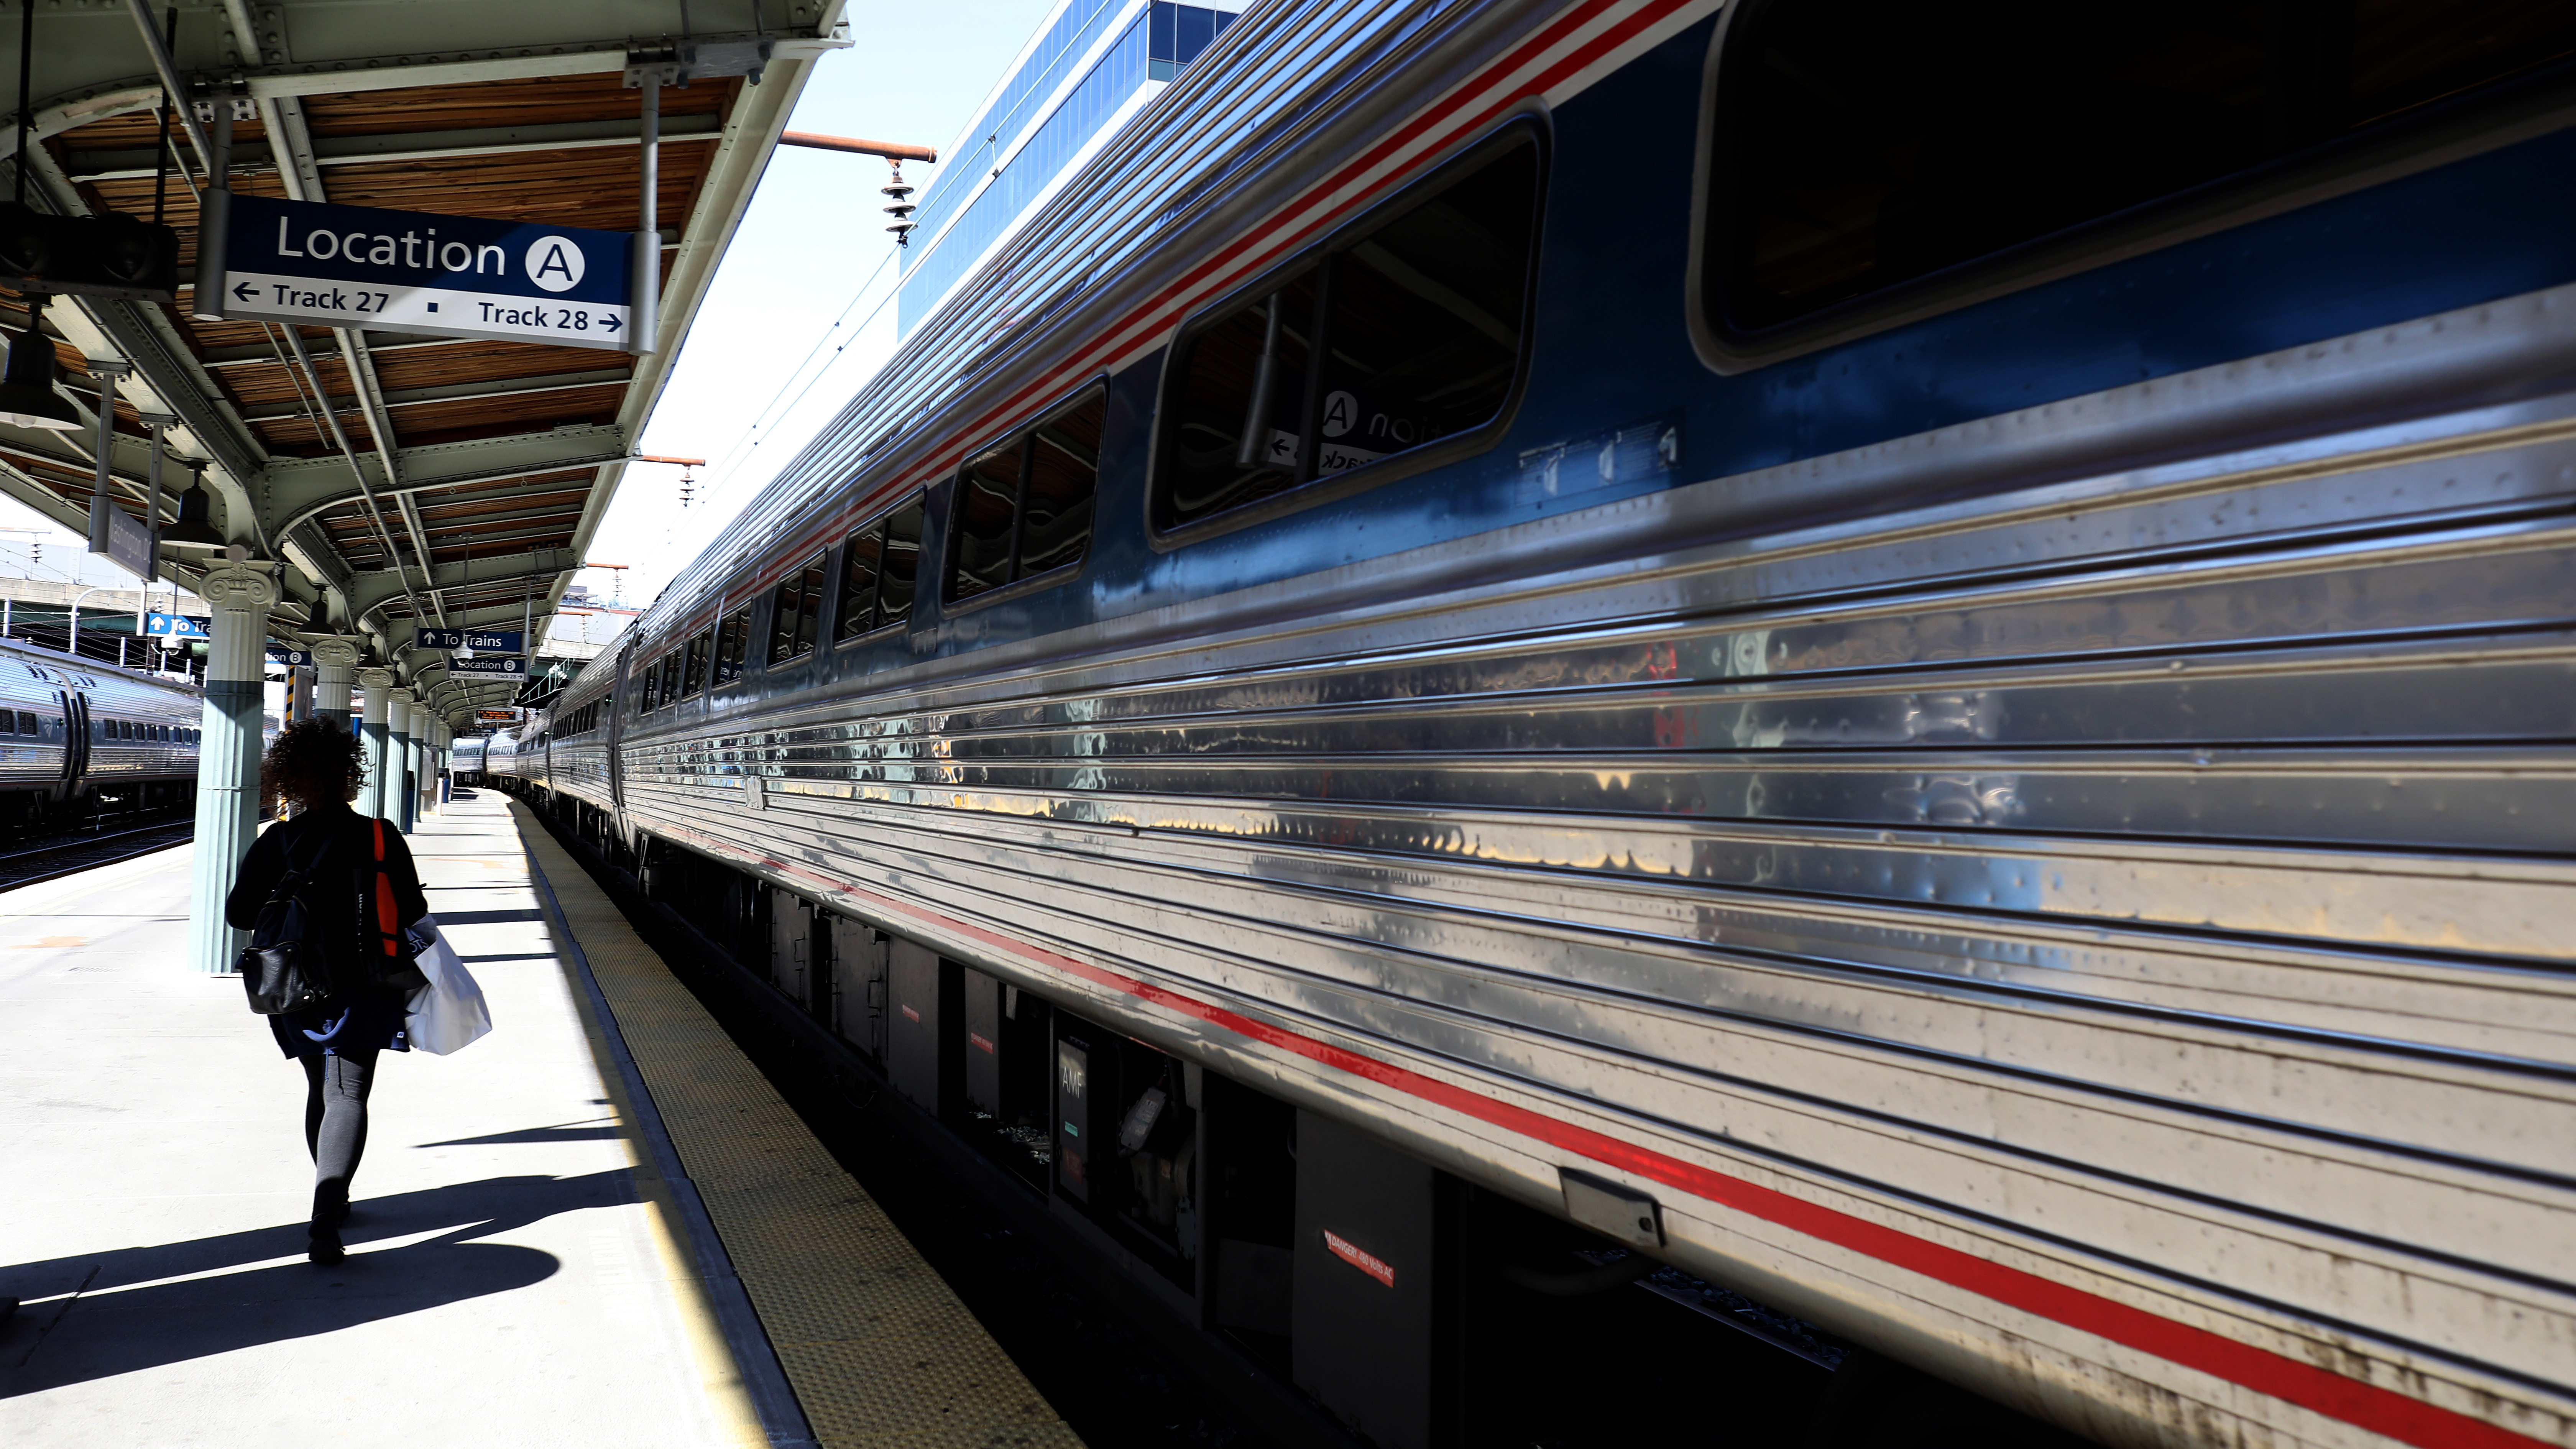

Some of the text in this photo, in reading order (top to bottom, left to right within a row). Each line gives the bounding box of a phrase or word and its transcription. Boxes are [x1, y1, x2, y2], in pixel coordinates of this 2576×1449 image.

[278, 216, 573, 281] Location A
[273, 284, 389, 313] Track 27
[478, 302, 588, 330] Track 28
[171, 619, 189, 632] To
[442, 633, 502, 647] To Trains
[1062, 1066, 1082, 1098] AMF
[1332, 1236, 1357, 1258] DANGER!
[1369, 1257, 1383, 1274] Volts
[1384, 1266, 1392, 1280] AC
